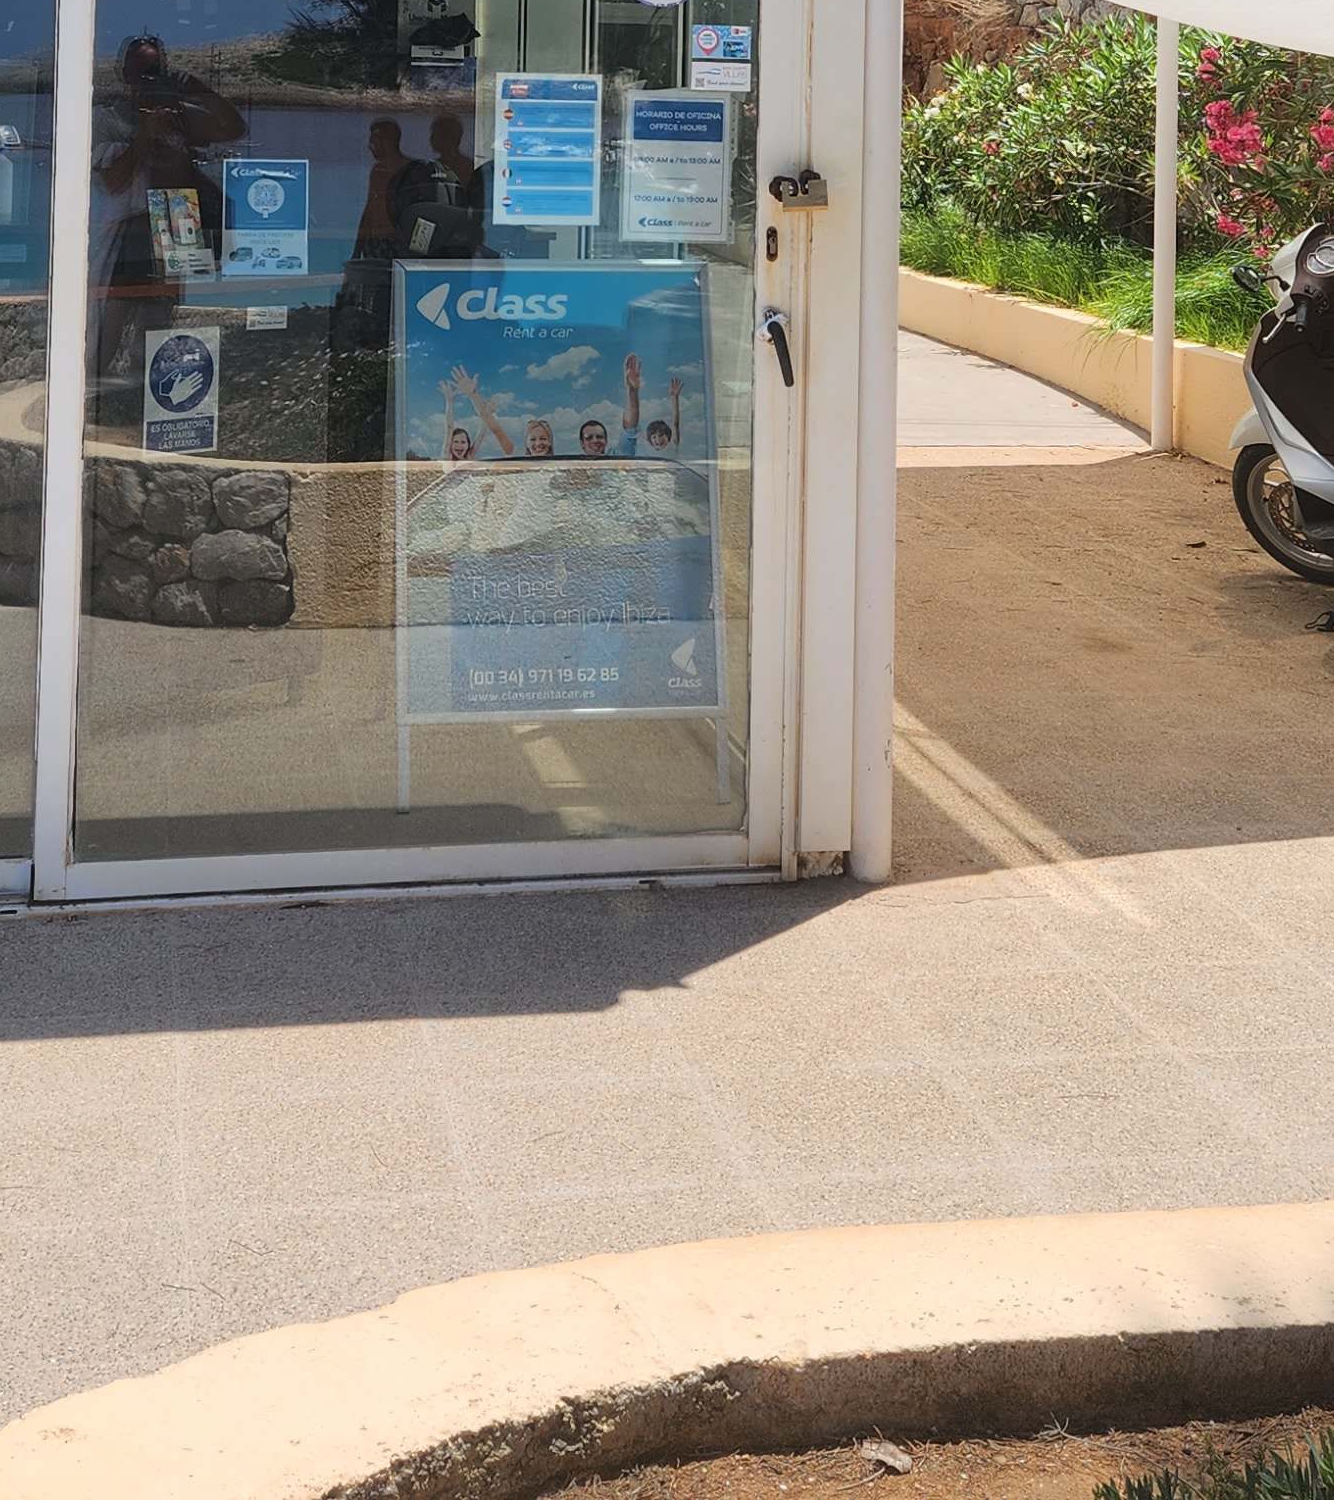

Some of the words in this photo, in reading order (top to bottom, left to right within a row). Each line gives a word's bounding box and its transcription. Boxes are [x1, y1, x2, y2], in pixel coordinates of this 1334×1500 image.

[635, 110, 674, 119] HORARIO
[674, 111, 686, 119] DE
[686, 112, 722, 120] OFICINA
[648, 123, 679, 131] OFFICE
[680, 124, 708, 132] HOURS
[646, 218, 674, 227] Class
[456, 286, 568, 321] Class
[503, 326, 535, 338] Rent
[538, 328, 548, 338] a
[550, 328, 574, 338] car
[150, 424, 161, 433] ES
[161, 418, 211, 432] OBLIGATORIO
[163, 431, 196, 441] LAVARSE
[158, 440, 173, 450] LAS
[174, 438, 201, 448] MANOS
[467, 575, 511, 600] The
[517, 575, 567, 599] best
[467, 607, 515, 634] way
[524, 605, 546, 628] to
[553, 605, 616, 633] enjoy
[622, 601, 671, 625] Ibiza
[469, 670, 495, 689] (00
[498, 669, 525, 688] 34)
[528, 668, 553, 684] 971
[558, 668, 574, 683] 19
[577, 668, 597, 683] 62
[600, 667, 620, 682] 85
[668, 677, 703, 689] Class
[468, 689, 596, 702] www.classrentacar.es
